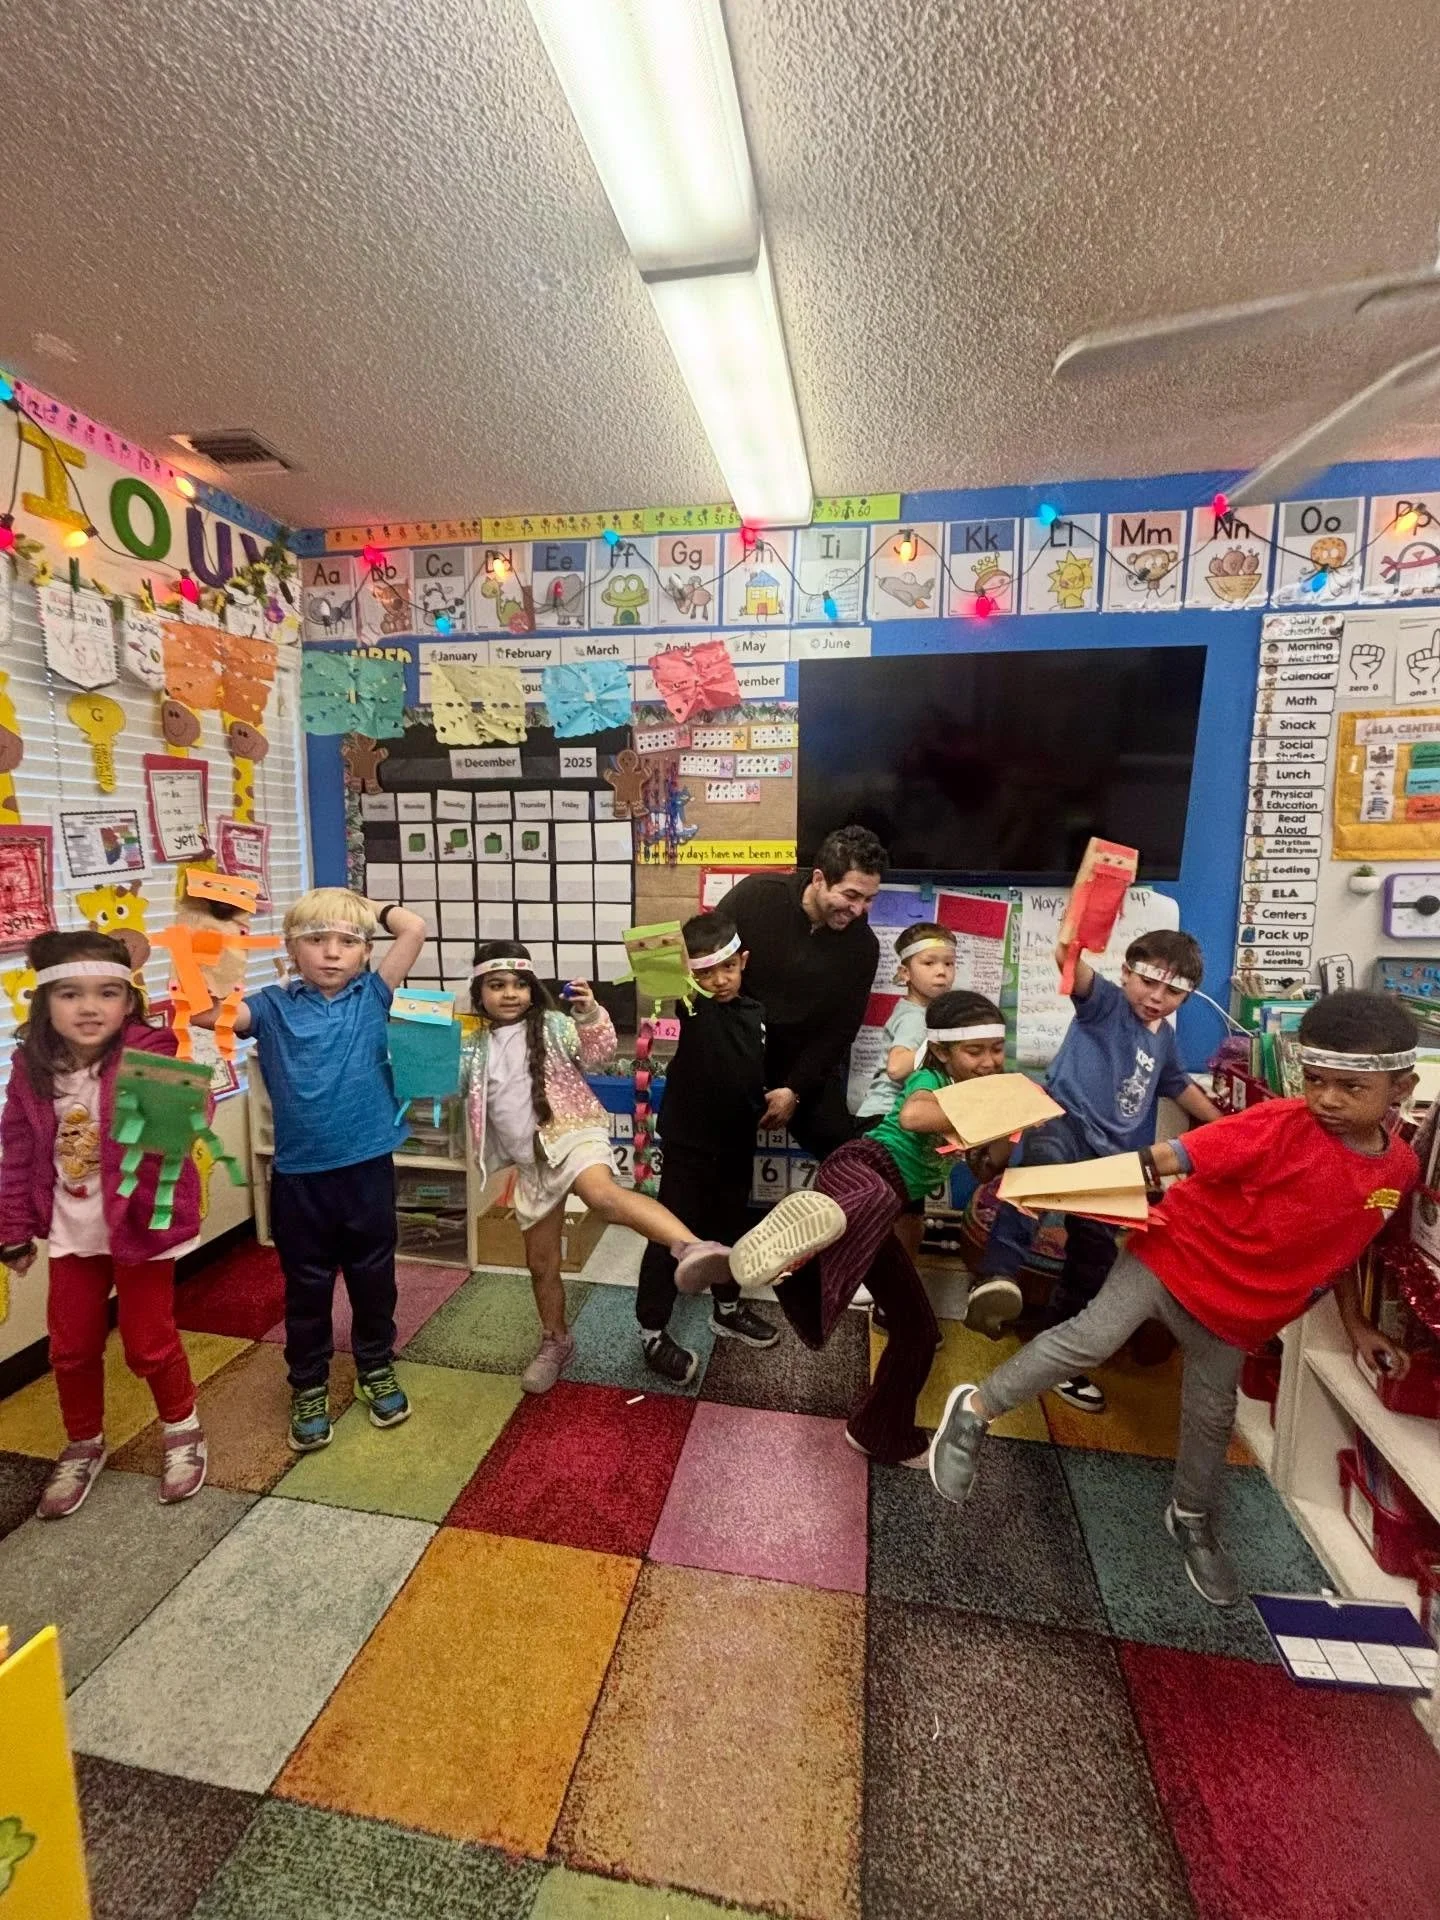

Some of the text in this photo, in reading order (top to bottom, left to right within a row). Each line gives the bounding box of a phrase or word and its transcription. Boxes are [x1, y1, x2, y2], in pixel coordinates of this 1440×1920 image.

[857, 503, 871, 517] 60
[110, 477, 171, 561] O
[1301, 506, 1341, 533] Oo
[1214, 511, 1249, 540] Nn
[965, 525, 998, 551] Kk
[1120, 519, 1172, 546] Mm
[186, 506, 232, 588] U
[821, 534, 841, 559] Ii
[546, 547, 573, 570] Ee
[671, 541, 702, 570] Gg
[426, 554, 453, 577] Cc
[313, 563, 340, 585] Aa
[742, 641, 766, 654] May
[822, 638, 851, 649] June
[1287, 642, 1333, 653] Morning
[505, 647, 552, 660] February
[586, 644, 620, 656] March
[437, 651, 478, 663] January
[737, 676, 780, 687] vember
[1279, 671, 1333, 682] Calendar
[1349, 684, 1369, 692] zero
[1409, 689, 1427, 697] one
[1285, 695, 1318, 706] Math
[1279, 719, 1316, 730] Snack
[1278, 740, 1314, 750] Social
[464, 757, 592, 769] December 2025
[1276, 768, 1311, 779] Lunch
[1270, 789, 1313, 800] Physical
[520, 801, 546, 809] Thursday
[561, 801, 580, 809] Friday
[1266, 801, 1318, 811] Education
[1278, 814, 1305, 824] Read
[1274, 826, 1308, 836] Aloud
[1274, 839, 1311, 848] Rhythm
[686, 846, 709, 861] days
[711, 846, 731, 859] have
[733, 850, 746, 858] we
[748, 846, 771, 859] been
[774, 848, 784, 858] in
[1266, 847, 1318, 857] and Rhyme
[1272, 866, 1310, 877] Coding
[1271, 889, 1299, 899] ELA
[1031, 895, 1064, 917] Ways
[1130, 890, 1151, 907] up
[1262, 909, 1308, 920] Centers
[1257, 928, 1309, 943] Pack up
[1265, 949, 1302, 958] Closing
[1262, 958, 1305, 967] Meeting
[1034, 982, 1056, 994] Tell
[665, 1026, 678, 1038] 62
[619, 1124, 630, 1132] 14
[613, 1146, 630, 1174] 2
[651, 1150, 664, 1178] 3
[762, 1158, 779, 1184] 6
